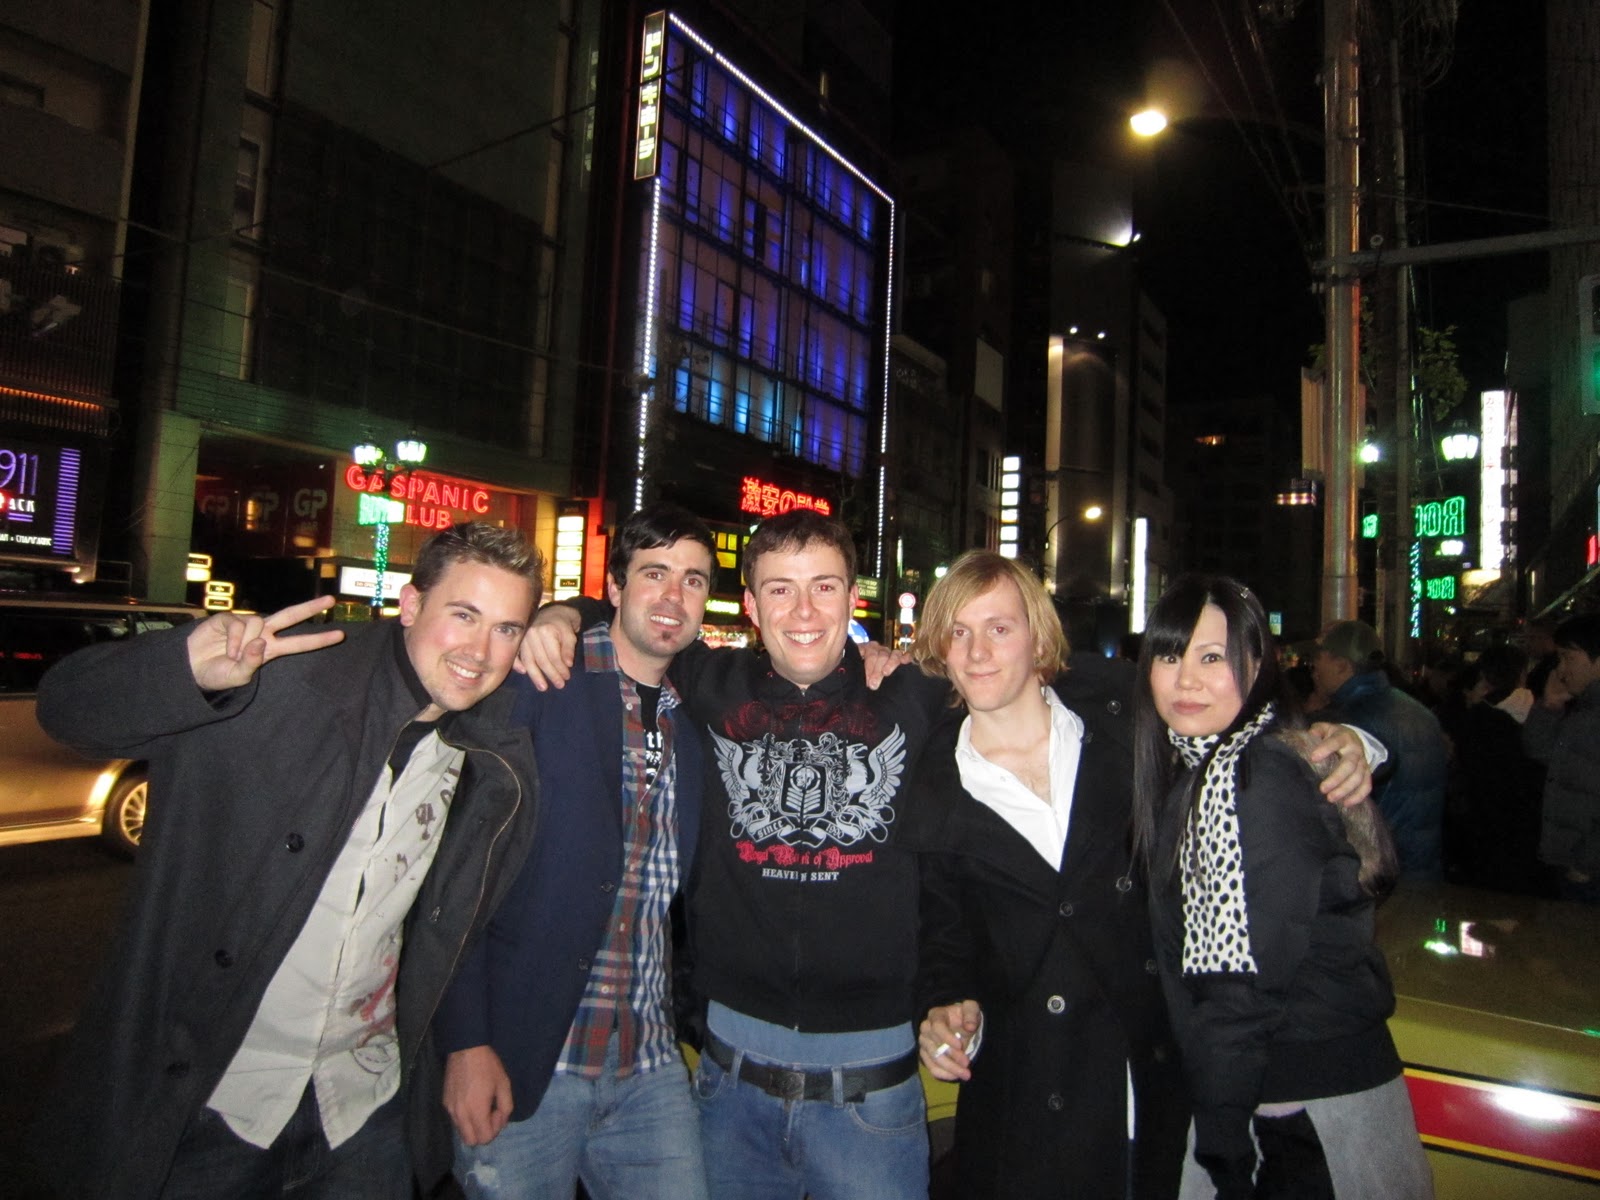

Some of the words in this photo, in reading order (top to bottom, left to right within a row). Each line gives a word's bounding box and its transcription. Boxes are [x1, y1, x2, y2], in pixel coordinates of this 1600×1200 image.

[294, 488, 328, 519] GP
[407, 475, 490, 514] PANIC
[405, 504, 451, 529] LUB
[820, 845, 873, 870] Approval
[810, 871, 839, 881] SENT
